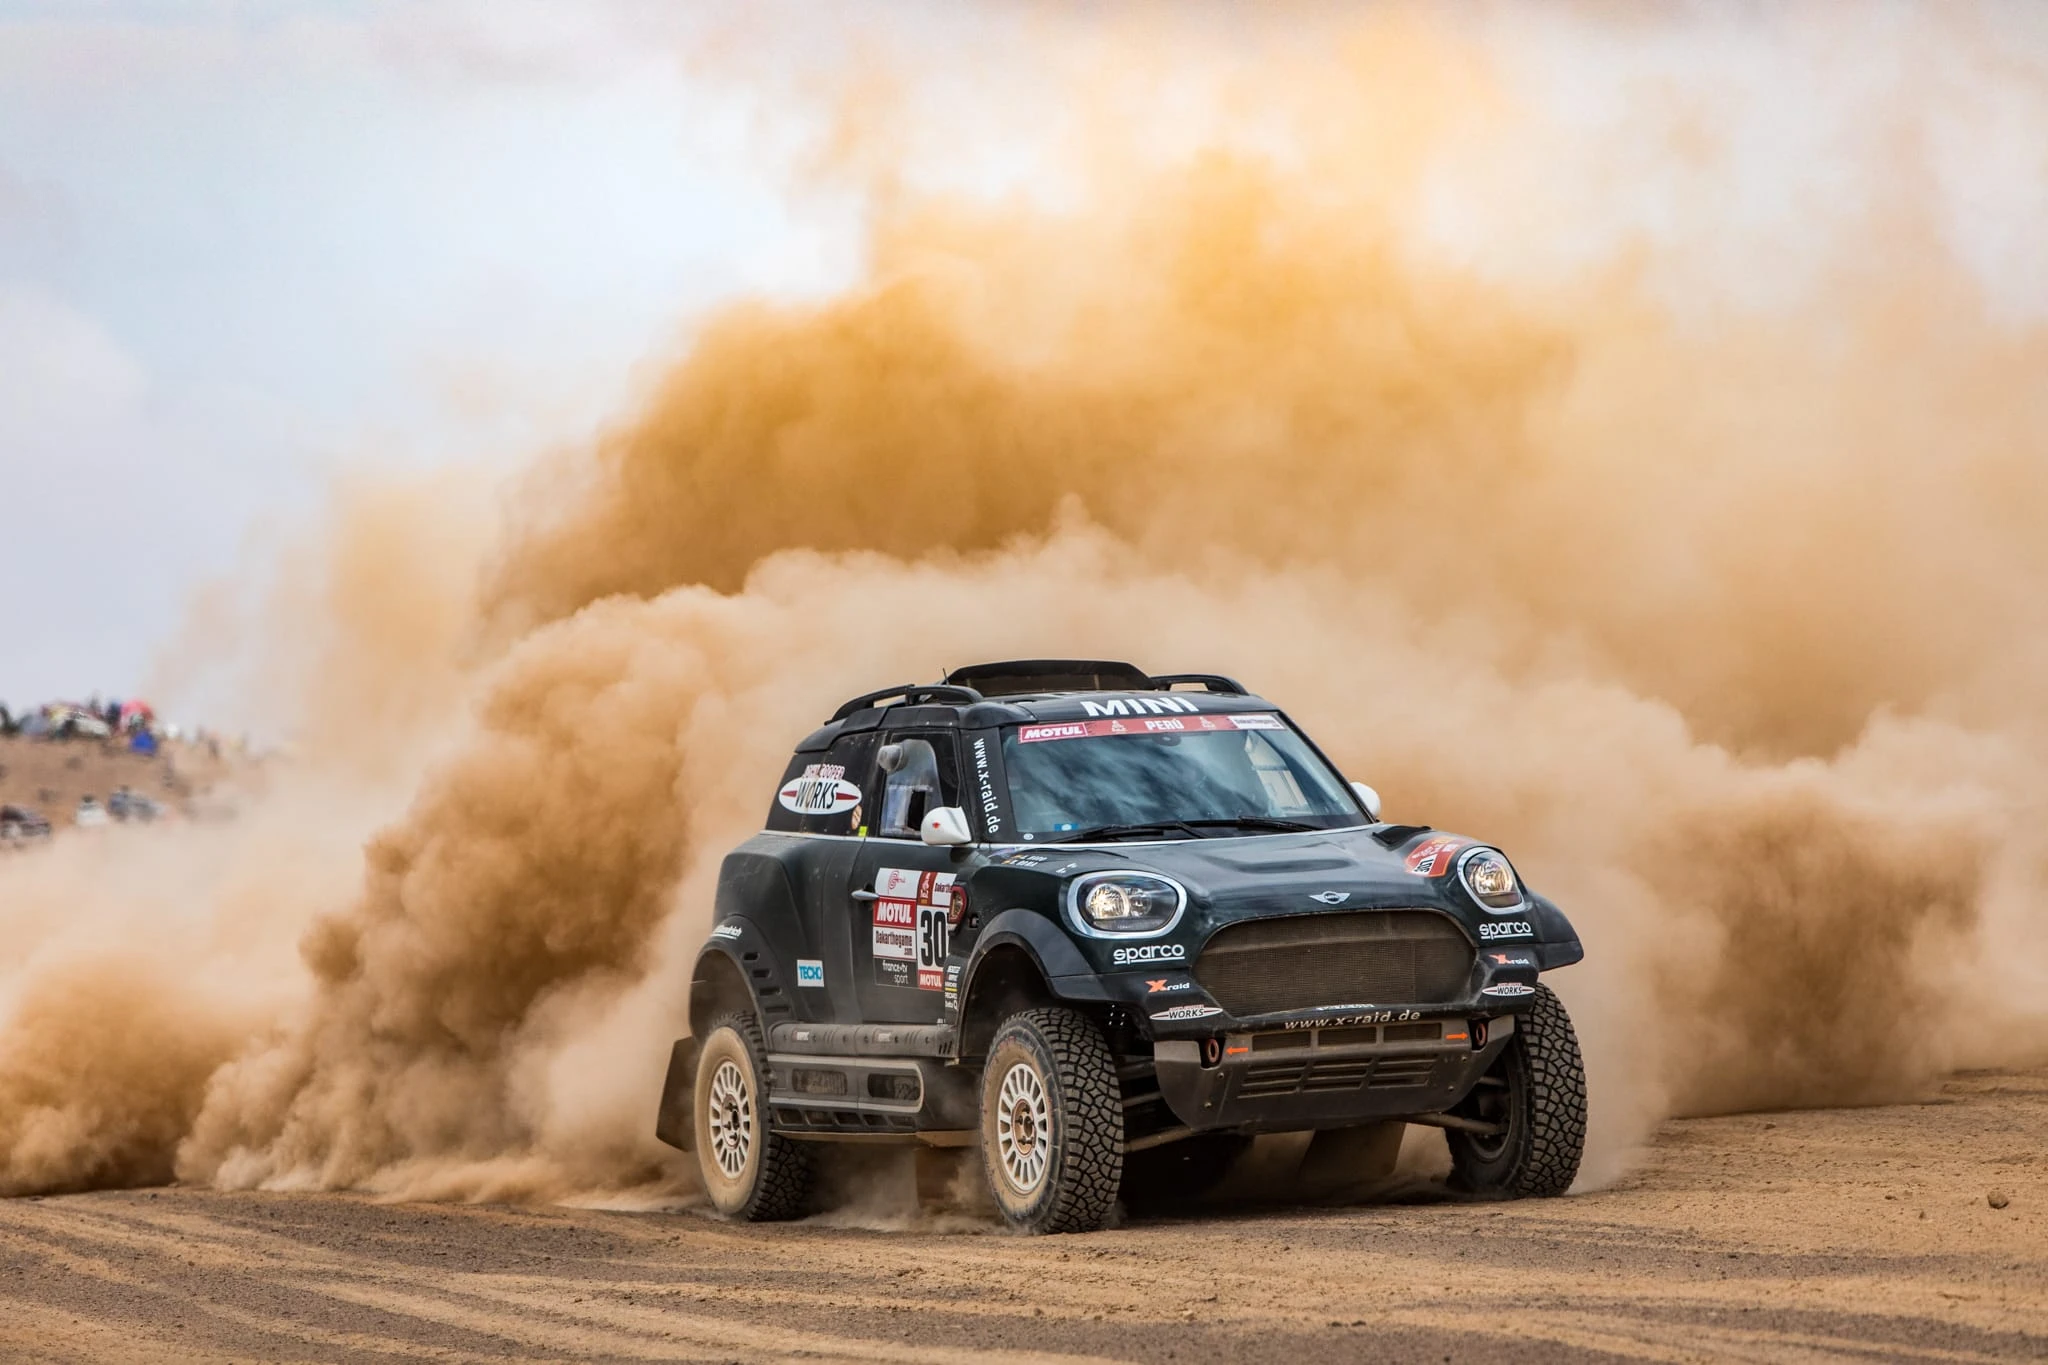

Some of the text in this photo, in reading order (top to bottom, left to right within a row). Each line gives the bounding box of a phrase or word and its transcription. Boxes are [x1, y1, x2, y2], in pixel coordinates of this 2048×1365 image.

[1080, 697, 1199, 716] MINI
[1024, 726, 1083, 739] MOTUL
[1144, 718, 1184, 731] PERÚ
[974, 738, 1000, 833] www.x-raid.de
[796, 781, 839, 809] WORKS
[877, 902, 912, 924] MOTUL
[1479, 922, 1533, 940] sparco
[1113, 944, 1185, 965] sparco
[920, 973, 942, 986] MOTUL
[1497, 986, 1522, 995] WORKS
[1169, 1009, 1205, 1019] WORKS
[1285, 1009, 1421, 1030] www.x-raid.de
